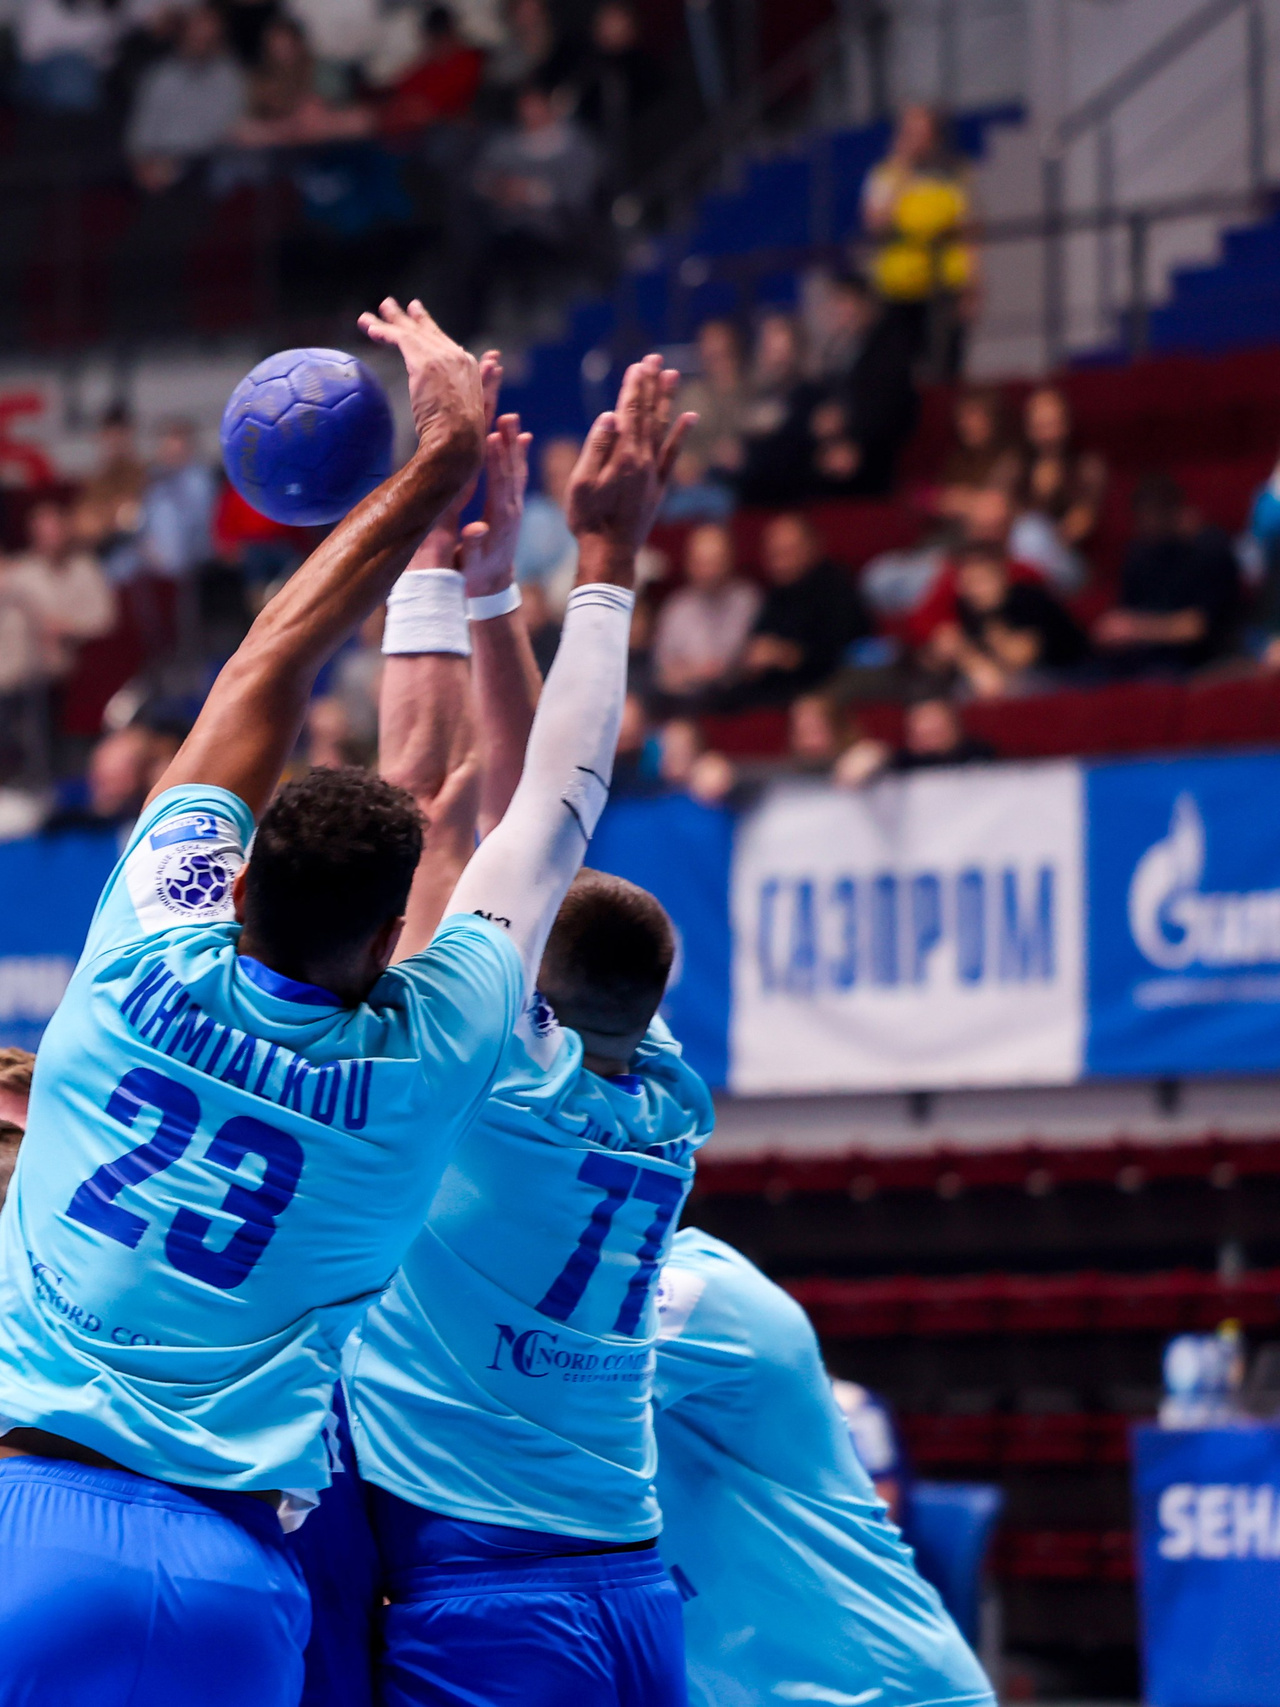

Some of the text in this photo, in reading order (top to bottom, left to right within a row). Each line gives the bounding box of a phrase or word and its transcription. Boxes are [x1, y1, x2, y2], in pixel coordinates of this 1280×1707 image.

[757, 862, 1057, 998] ГАЗПРОМ
[65, 1067, 305, 1290] 23
[536, 1151, 685, 1336] 77
[536, 1346, 599, 1371] NORD
[1158, 1483, 1280, 1560] SEH
